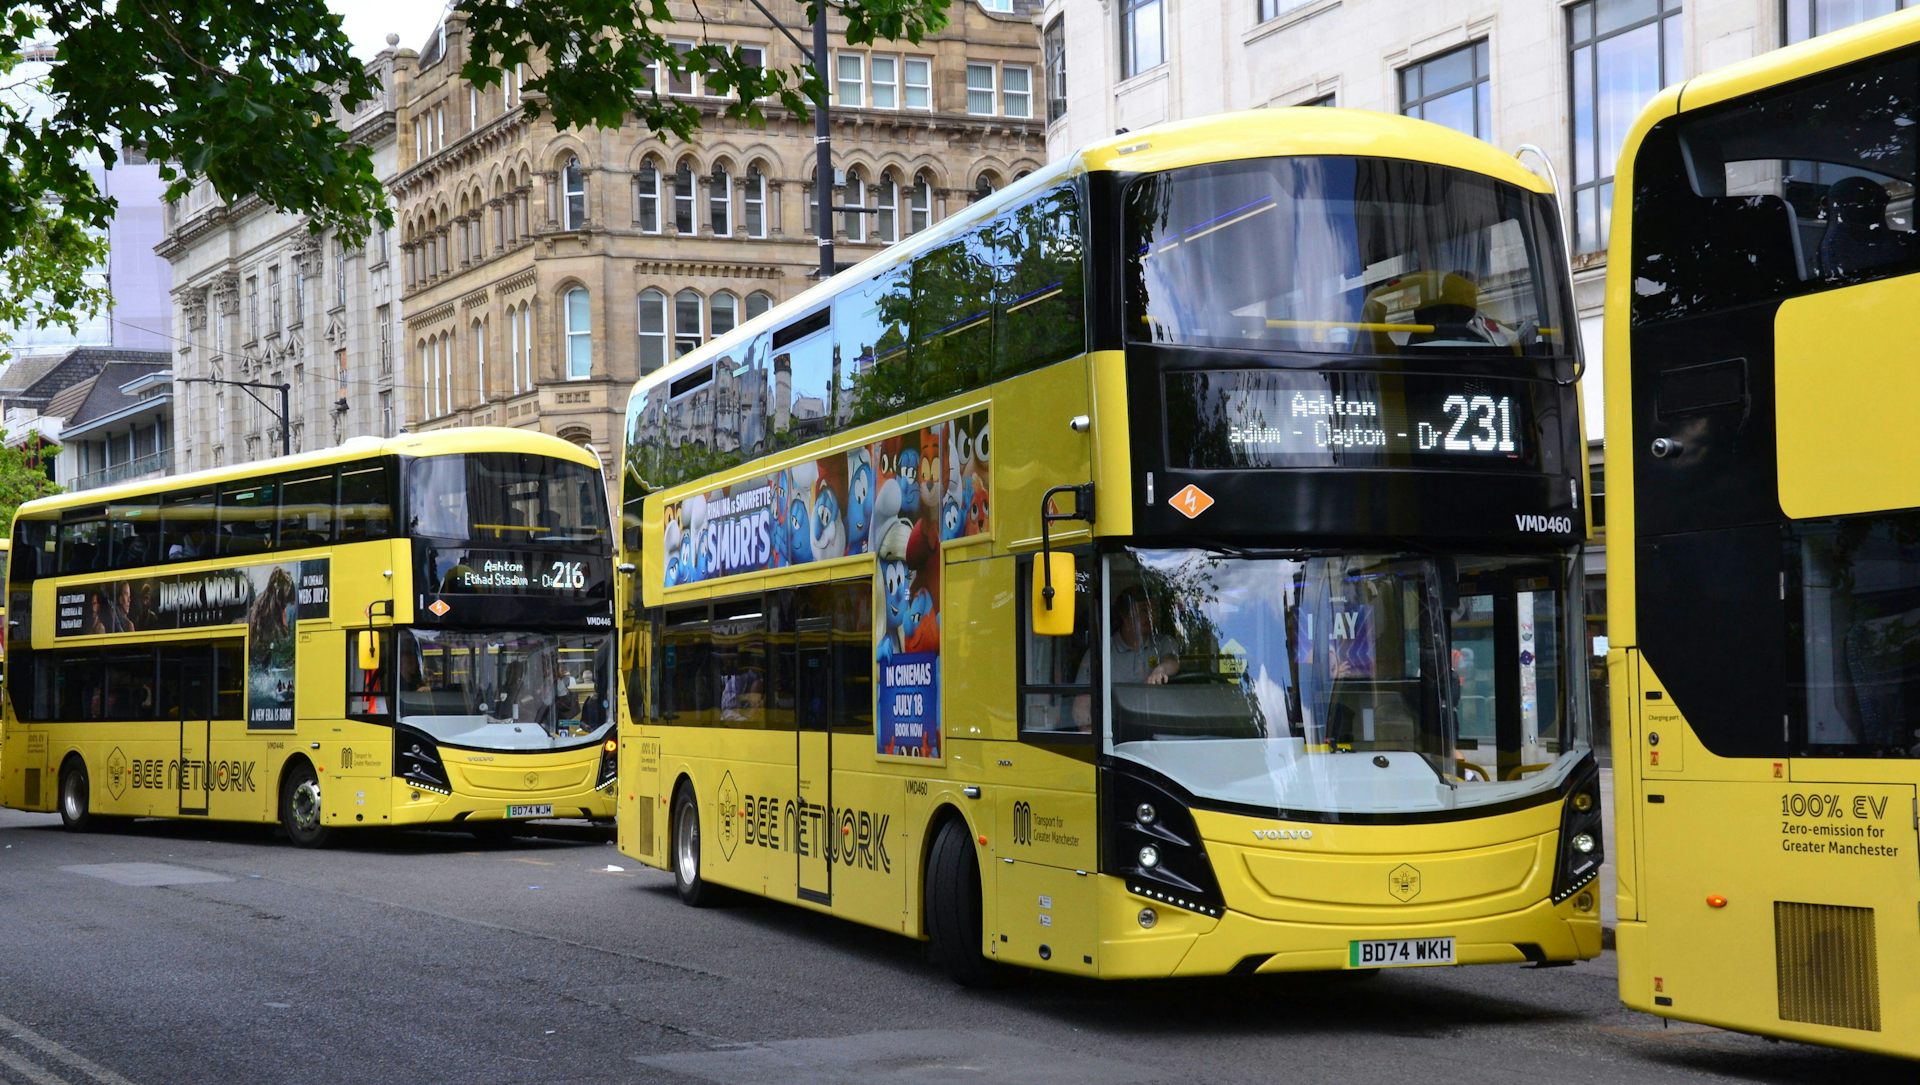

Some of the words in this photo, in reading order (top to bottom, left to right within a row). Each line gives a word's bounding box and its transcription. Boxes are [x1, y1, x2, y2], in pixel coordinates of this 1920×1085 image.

[1291, 391, 1376, 417] Ashton
[1315, 420, 1386, 448] Clayton
[1418, 422, 1442, 449] Dr
[1443, 395, 1515, 451] 231
[707, 497, 731, 520] RIHANA
[735, 486, 771, 513] SMURFETTE
[1515, 514, 1572, 534] VMD460
[707, 508, 771, 574] SMURFS
[484, 560, 524, 573] Ashton
[552, 561, 585, 588] 216
[464, 572, 493, 586] Etihad
[158, 580, 203, 613] JURASSIC
[204, 575, 249, 609] WORLD
[886, 666, 895, 687] IN
[895, 663, 931, 687] CINEMAS
[893, 694, 913, 717] JULY
[913, 694, 923, 716] 18
[894, 723, 909, 737] BOOK
[909, 723, 923, 738] NOW
[1648, 715, 1669, 723] Charging
[1669, 715, 1680, 723] port
[132, 759, 163, 789] BEE
[167, 758, 256, 793] NETWORK
[905, 780, 928, 796] VMD460
[512, 806, 533, 816] BD74
[1782, 793, 1844, 819] 100%
[1852, 794, 1889, 820] EV
[1034, 812, 1056, 829] Transport
[1056, 815, 1064, 828] for
[1782, 821, 1865, 838] Zero-emission
[1867, 824, 1885, 838] for
[744, 794, 779, 850] BEE
[784, 799, 891, 875] NETWORK
[1033, 828, 1051, 843] Greater
[1051, 831, 1080, 847] Manchester
[1252, 829, 1313, 840] VOLVO
[1782, 839, 1826, 854] Greater
[1828, 841, 1899, 858] Manchester
[1362, 941, 1410, 962] BD74
[1416, 939, 1451, 960] WKH
